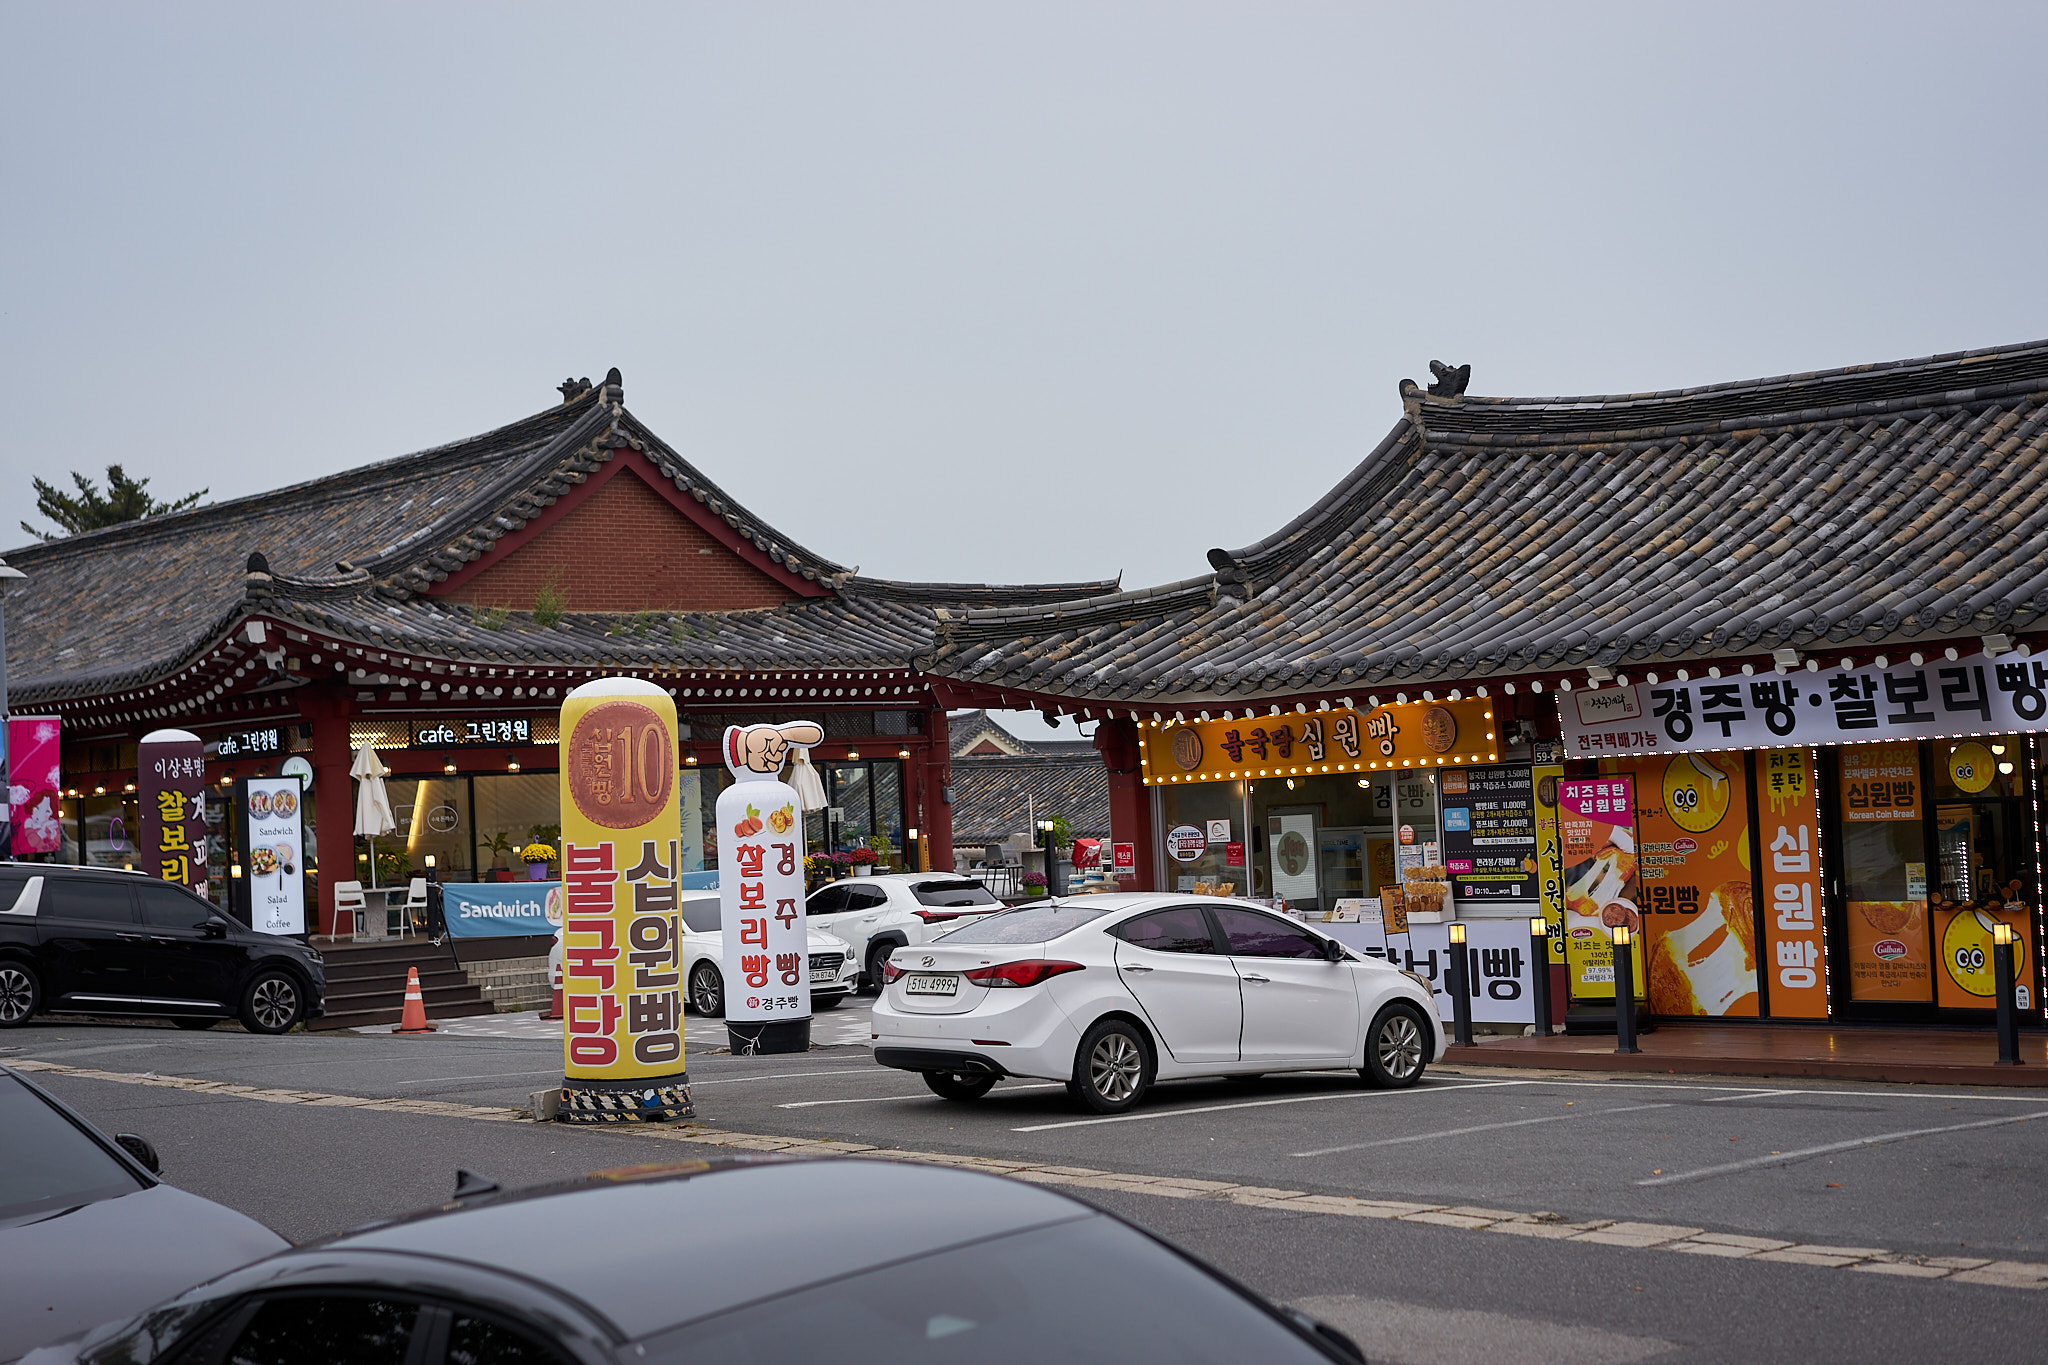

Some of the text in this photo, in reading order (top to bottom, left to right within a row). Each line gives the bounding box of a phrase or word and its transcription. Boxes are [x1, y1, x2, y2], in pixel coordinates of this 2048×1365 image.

[218, 728, 278, 755] cafe. 그린정원
[418, 720, 528, 743] cafe. 그린정원
[1220, 724, 1294, 763] 불국당
[1298, 711, 1400, 761] 십원빵
[1578, 730, 1658, 751] 전국택배가능
[589, 728, 615, 805] 십원빵
[617, 723, 665, 804] 10
[1769, 752, 1801, 769] 치즈
[1843, 749, 1918, 767] 원유 97.99%
[1844, 766, 1914, 779] 모짜렐라 자연치즈
[1771, 773, 1803, 793] 폭탄
[1847, 780, 1916, 809] 십원빵
[1580, 798, 1627, 814] 십원빵
[1848, 809, 1915, 820] Korean Coin Bread
[259, 827, 293, 836] Sandwich
[267, 895, 288, 904] Salad
[459, 899, 541, 920] Sandwich
[1769, 824, 1818, 989] 십원빵
[266, 919, 291, 929] Coffee
[736, 843, 771, 988] 찰보리빵
[770, 842, 801, 987] 경주빵
[565, 842, 622, 1066] 불국당
[625, 840, 682, 1065] 십원빵
[1573, 941, 1602, 950] 치즈는
[1876, 943, 1904, 955] Galbani
[820, 970, 835, 979] 8746
[930, 978, 952, 991] 4999
[762, 996, 799, 1011] 경주빵
